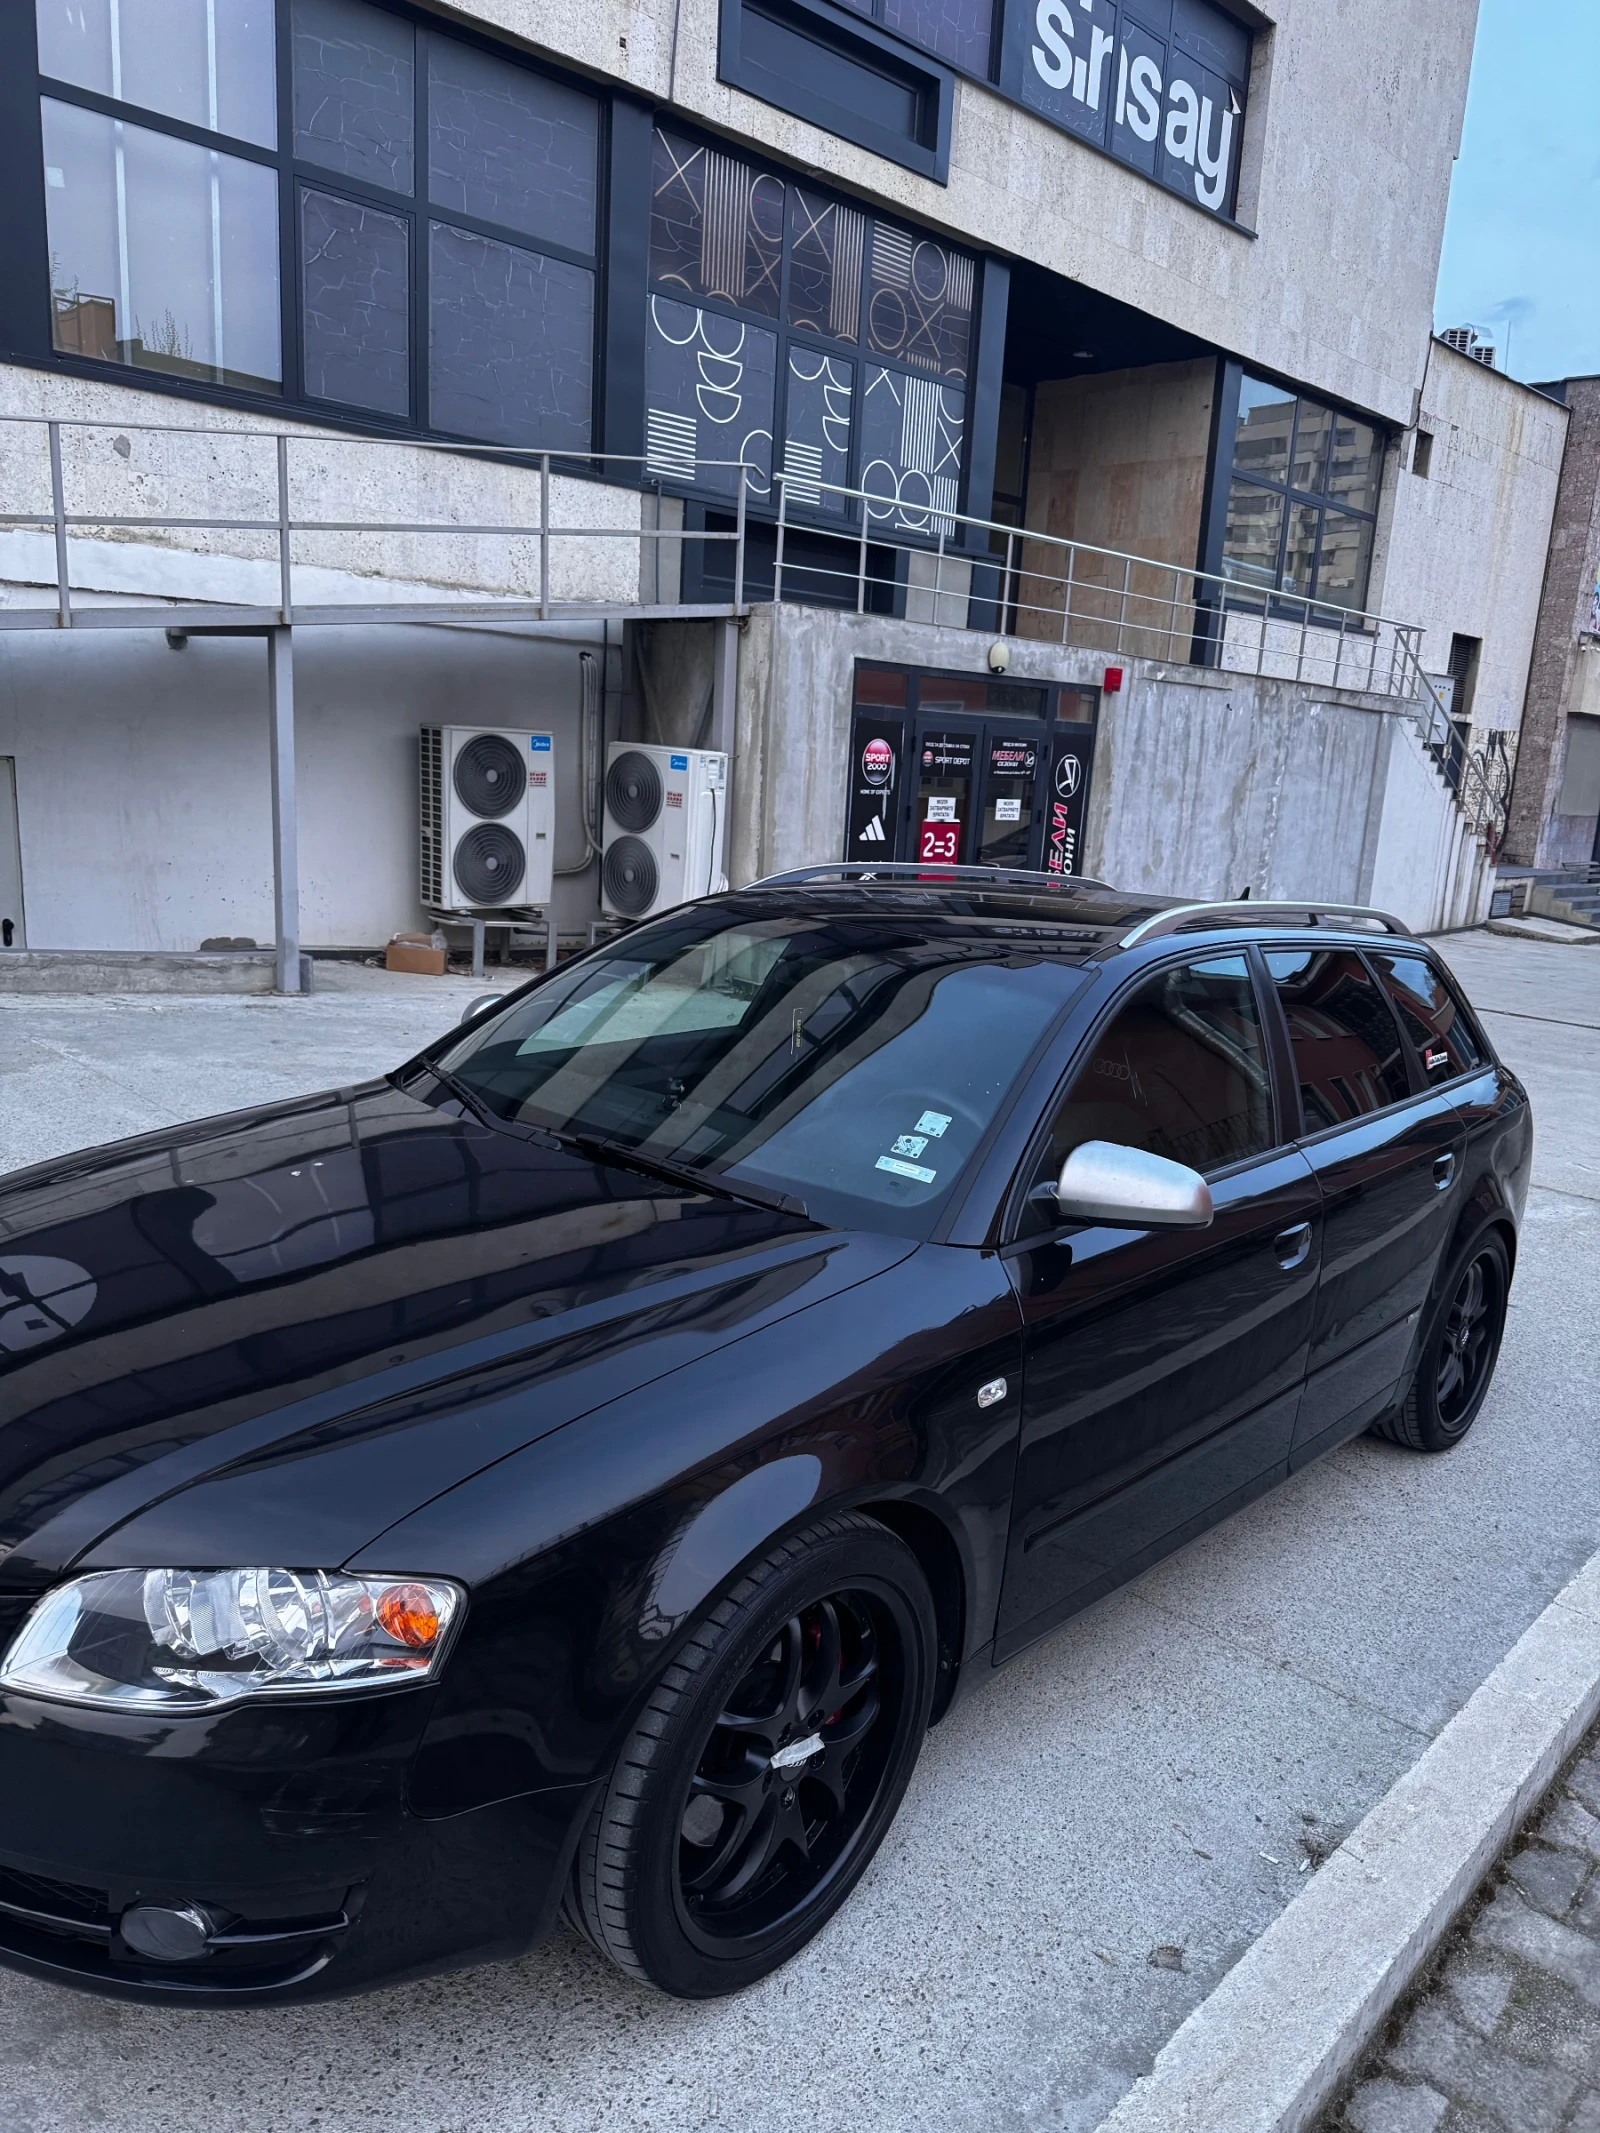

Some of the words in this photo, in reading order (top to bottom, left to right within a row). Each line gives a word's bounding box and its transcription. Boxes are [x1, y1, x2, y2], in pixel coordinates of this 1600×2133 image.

[865, 753, 890, 763] SPORT
[935, 756, 953, 764] SPORT
[953, 757, 971, 765] DEPOT
[992, 751, 1025, 761] МЕБЕЛИ
[923, 832, 956, 857] 2=3
